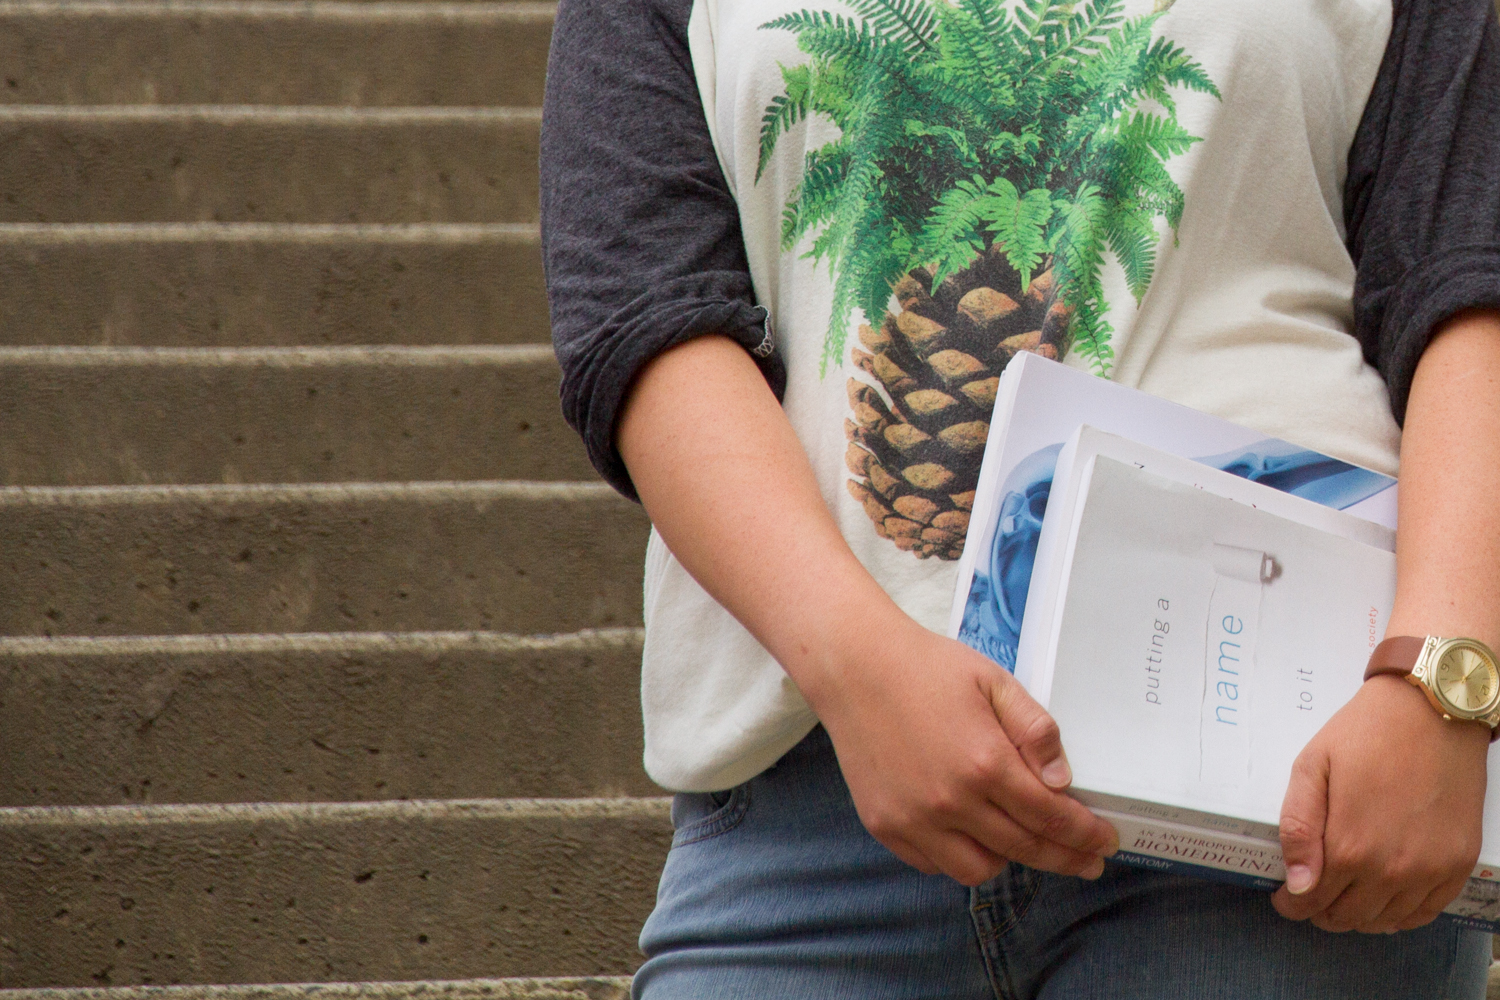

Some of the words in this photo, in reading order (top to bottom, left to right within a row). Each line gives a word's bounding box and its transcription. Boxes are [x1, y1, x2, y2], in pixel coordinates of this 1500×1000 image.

[1157, 598, 1170, 611] a
[1368, 606, 1379, 648] society
[1145, 618, 1170, 705] putting
[1215, 614, 1243, 726] name
[1296, 668, 1313, 683] it
[1296, 691, 1313, 711] to
[1129, 804, 1169, 819] putting
[1202, 816, 1239, 829] name
[1133, 838, 1278, 874] BIOMEDICINE
[1138, 829, 1154, 837] AN
[1160, 832, 1267, 858] ANTHROPOLOGY
[1115, 853, 1174, 870] ANATOMY
